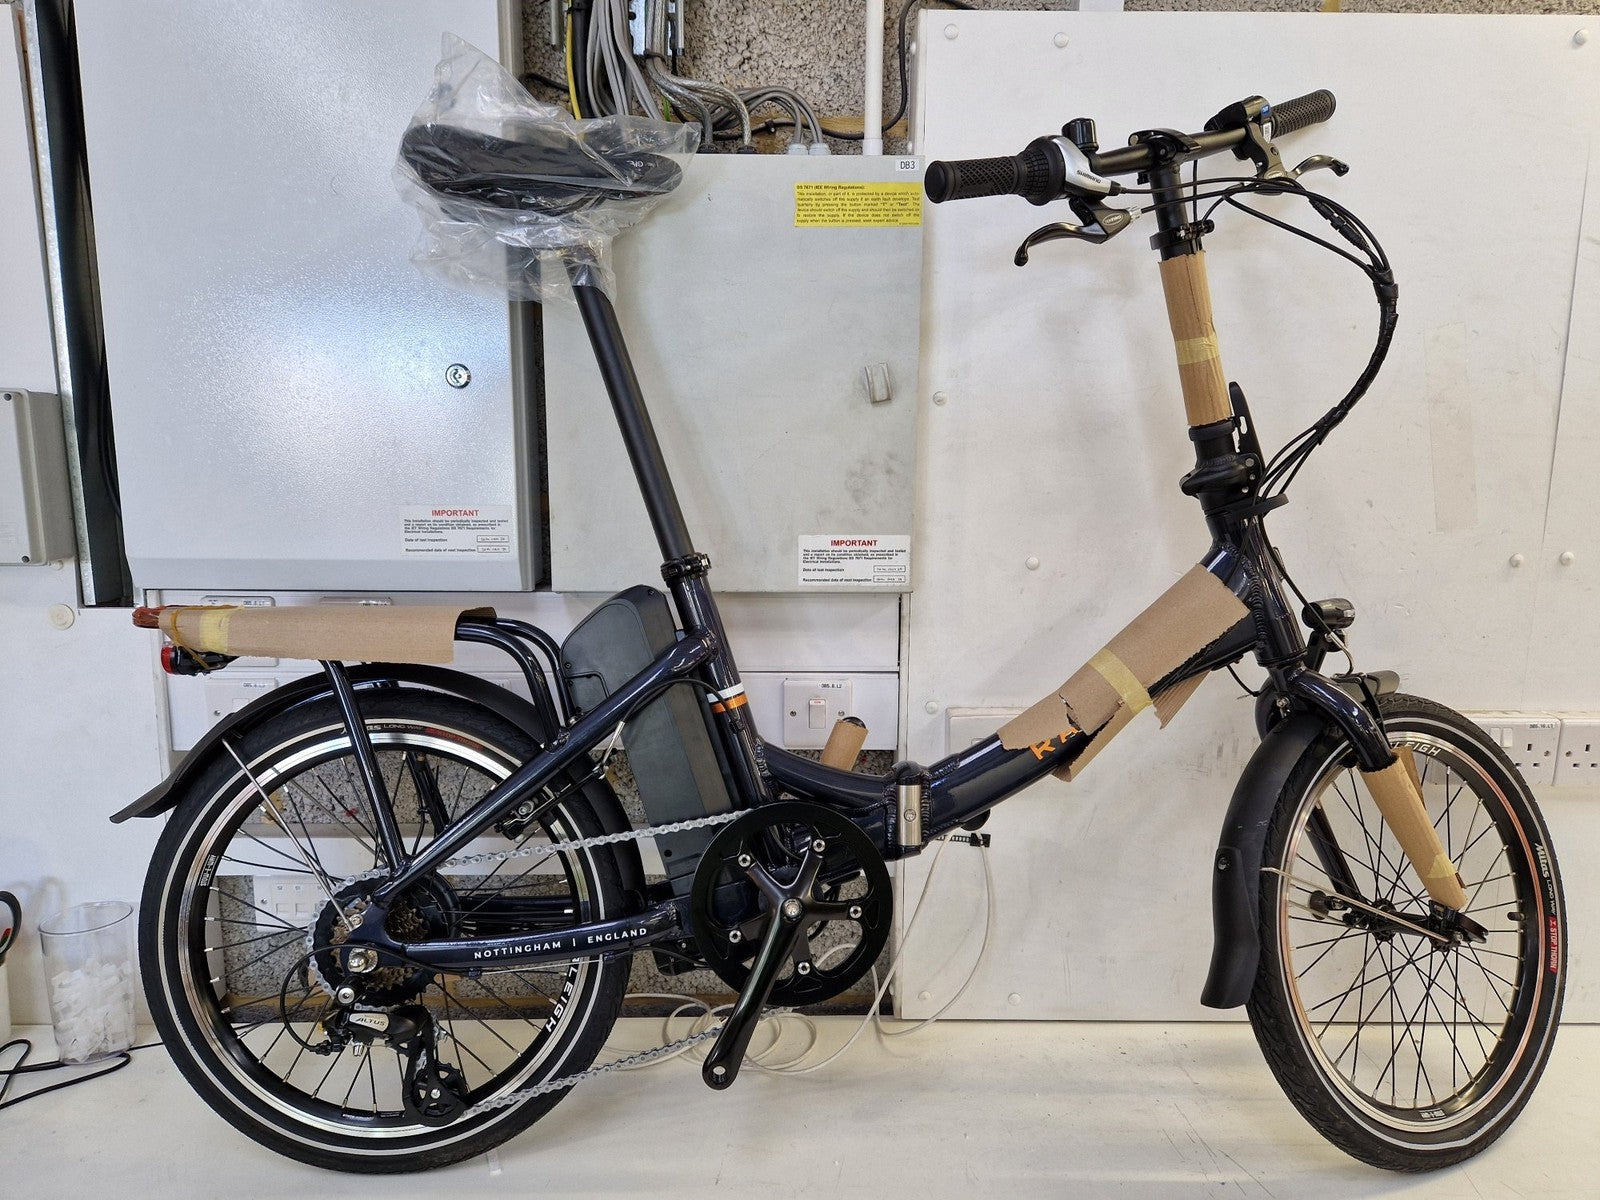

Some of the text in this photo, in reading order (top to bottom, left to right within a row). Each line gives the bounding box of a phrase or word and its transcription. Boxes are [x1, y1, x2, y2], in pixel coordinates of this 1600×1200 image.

[900, 160, 916, 170] DB3
[1076, 170, 1102, 184] SHIMANO
[1390, 742, 1441, 756] LEIGH
[1546, 880, 1554, 900] LONG
[474, 940, 562, 960] NOTTINGHAM
[588, 928, 648, 944] ENGLAND
[356, 1018, 385, 1026] ALTUS
